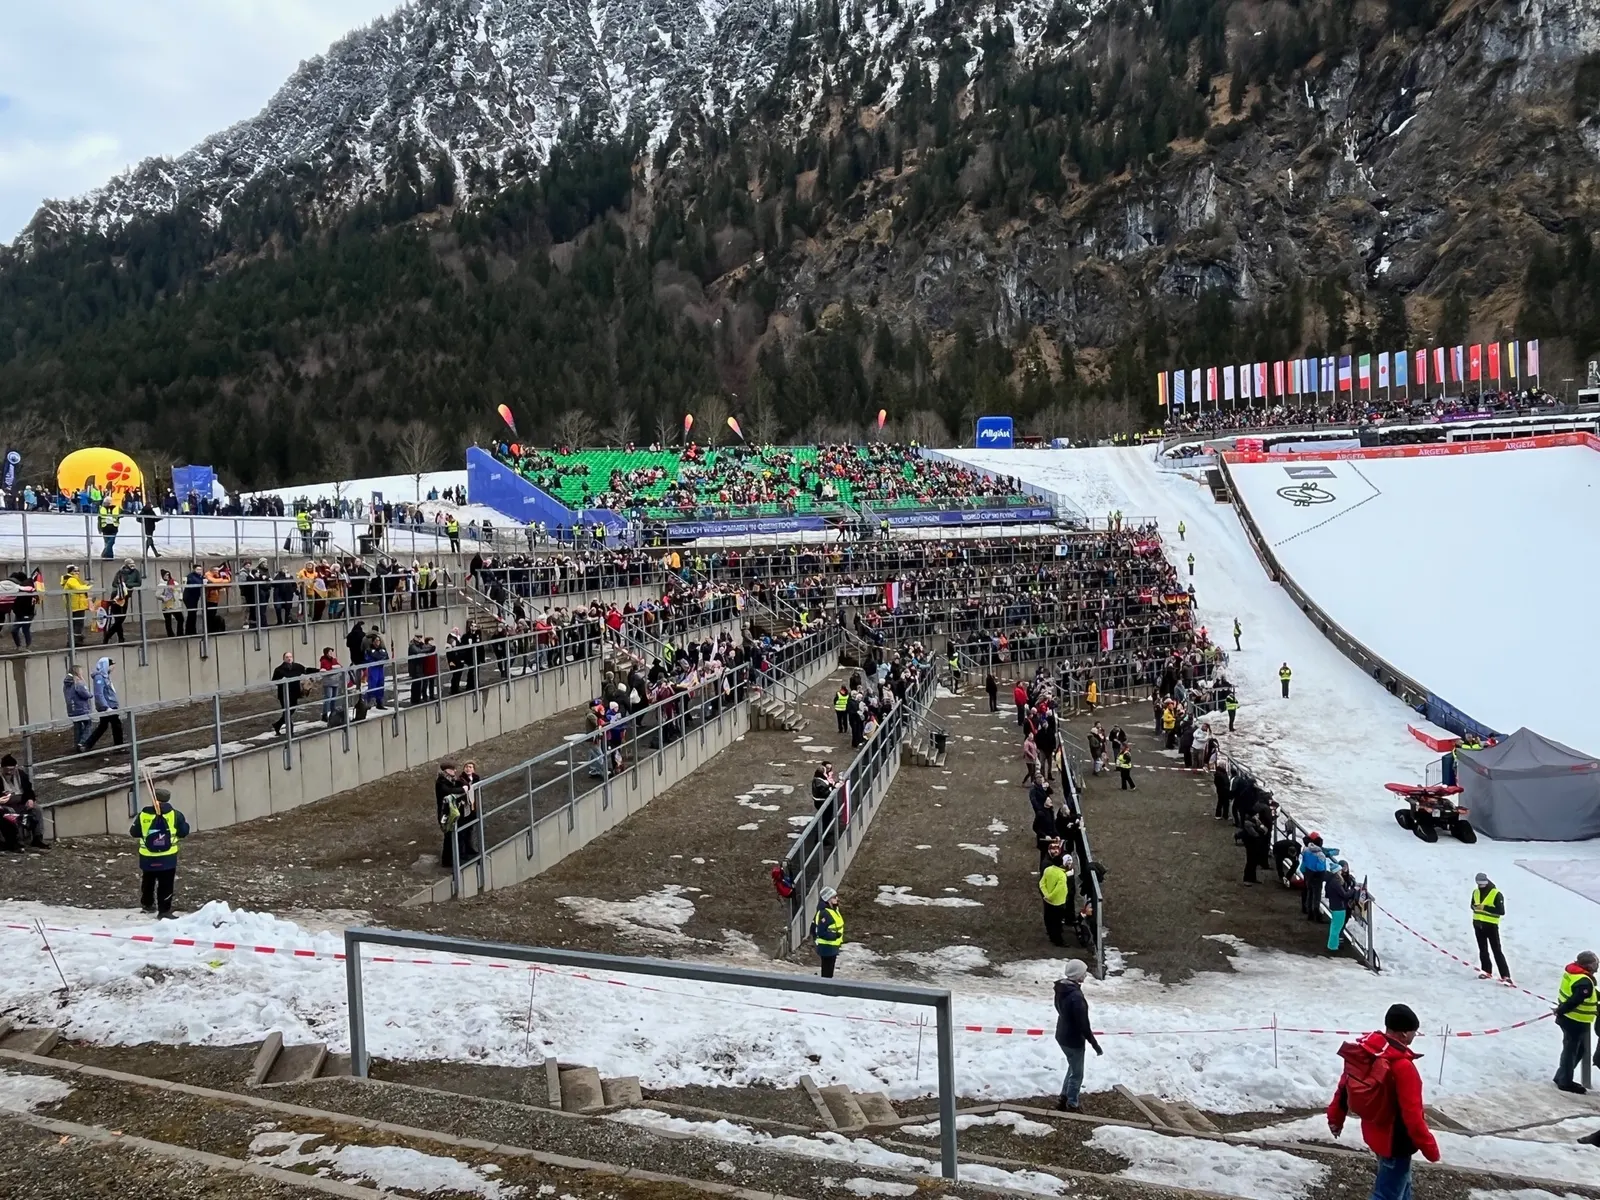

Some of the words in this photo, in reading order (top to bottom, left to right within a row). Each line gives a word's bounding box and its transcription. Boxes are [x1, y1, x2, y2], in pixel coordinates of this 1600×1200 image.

[1504, 440, 1536, 450] ARGETA
[1336, 452, 1366, 460] ARGETA
[1418, 447, 1450, 456] ARGETA
[961, 513, 980, 521] WORLD
[980, 512, 991, 520] CUP
